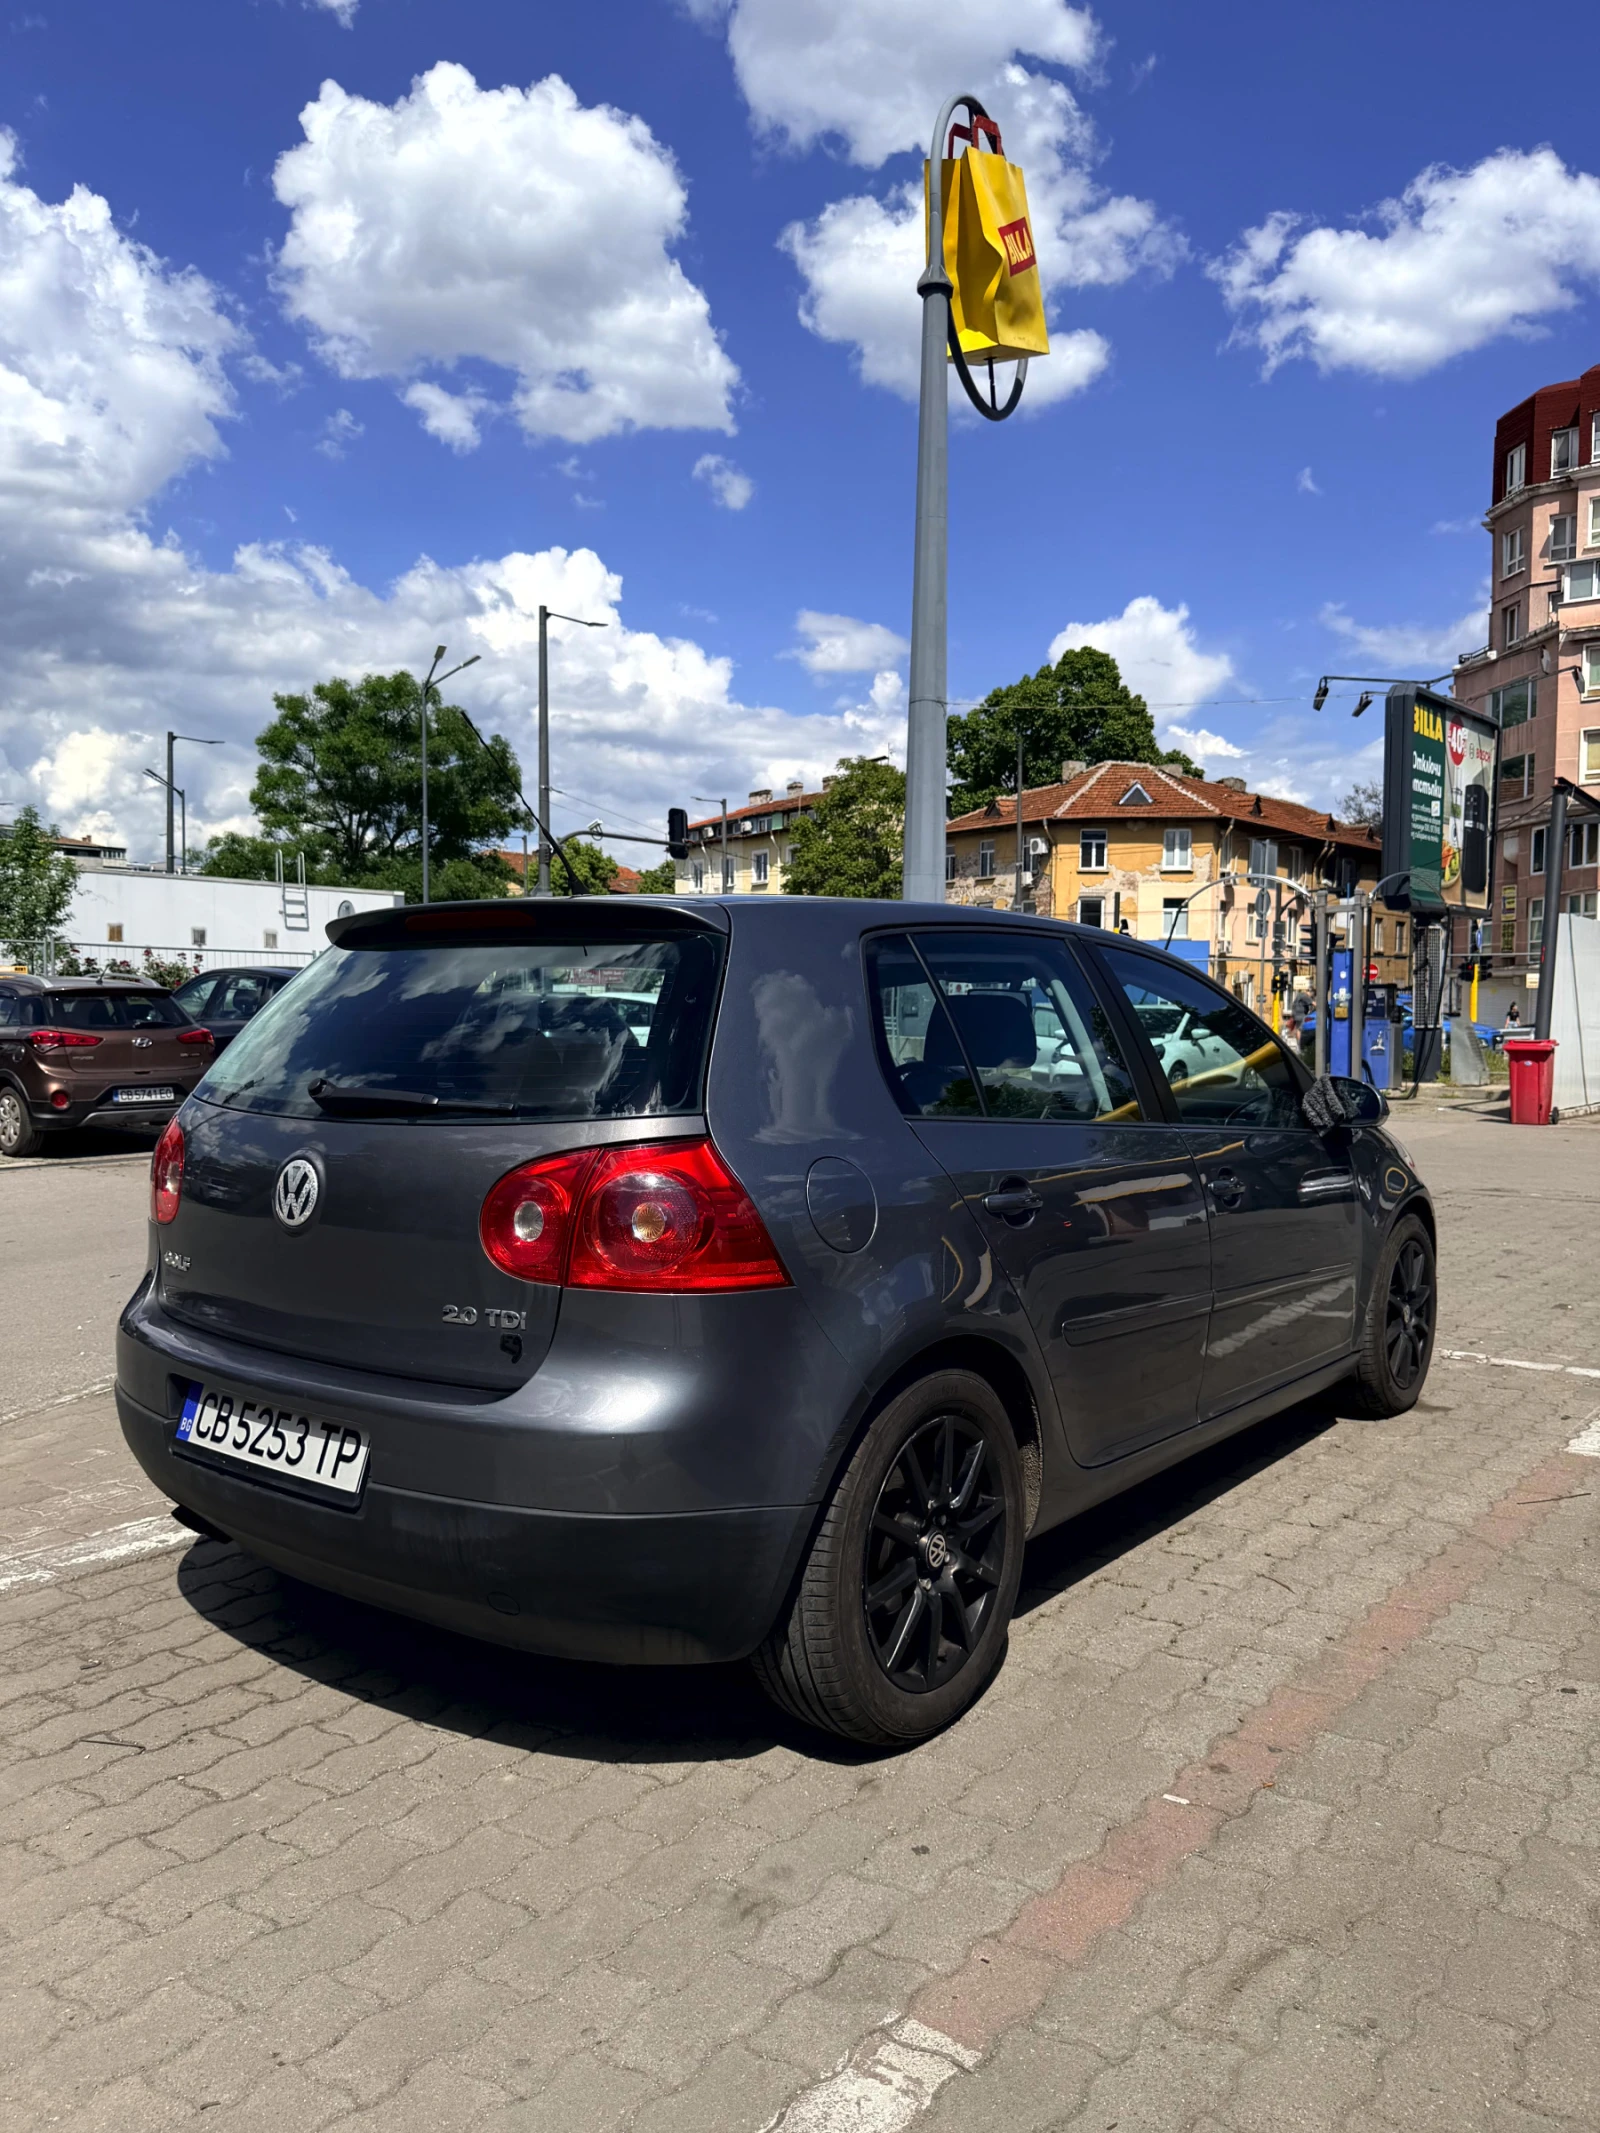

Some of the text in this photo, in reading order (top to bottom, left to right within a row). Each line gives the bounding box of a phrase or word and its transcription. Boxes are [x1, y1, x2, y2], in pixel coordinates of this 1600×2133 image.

[1004, 227, 1033, 267] BILLA
[1476, 747, 1491, 763] BOSCH
[164, 1250, 191, 1272] GOLF
[484, 1308, 527, 1330] TDI
[179, 1417, 193, 1432] BG
[232, 1401, 310, 1466] 5253
[316, 1421, 362, 1479] TP
